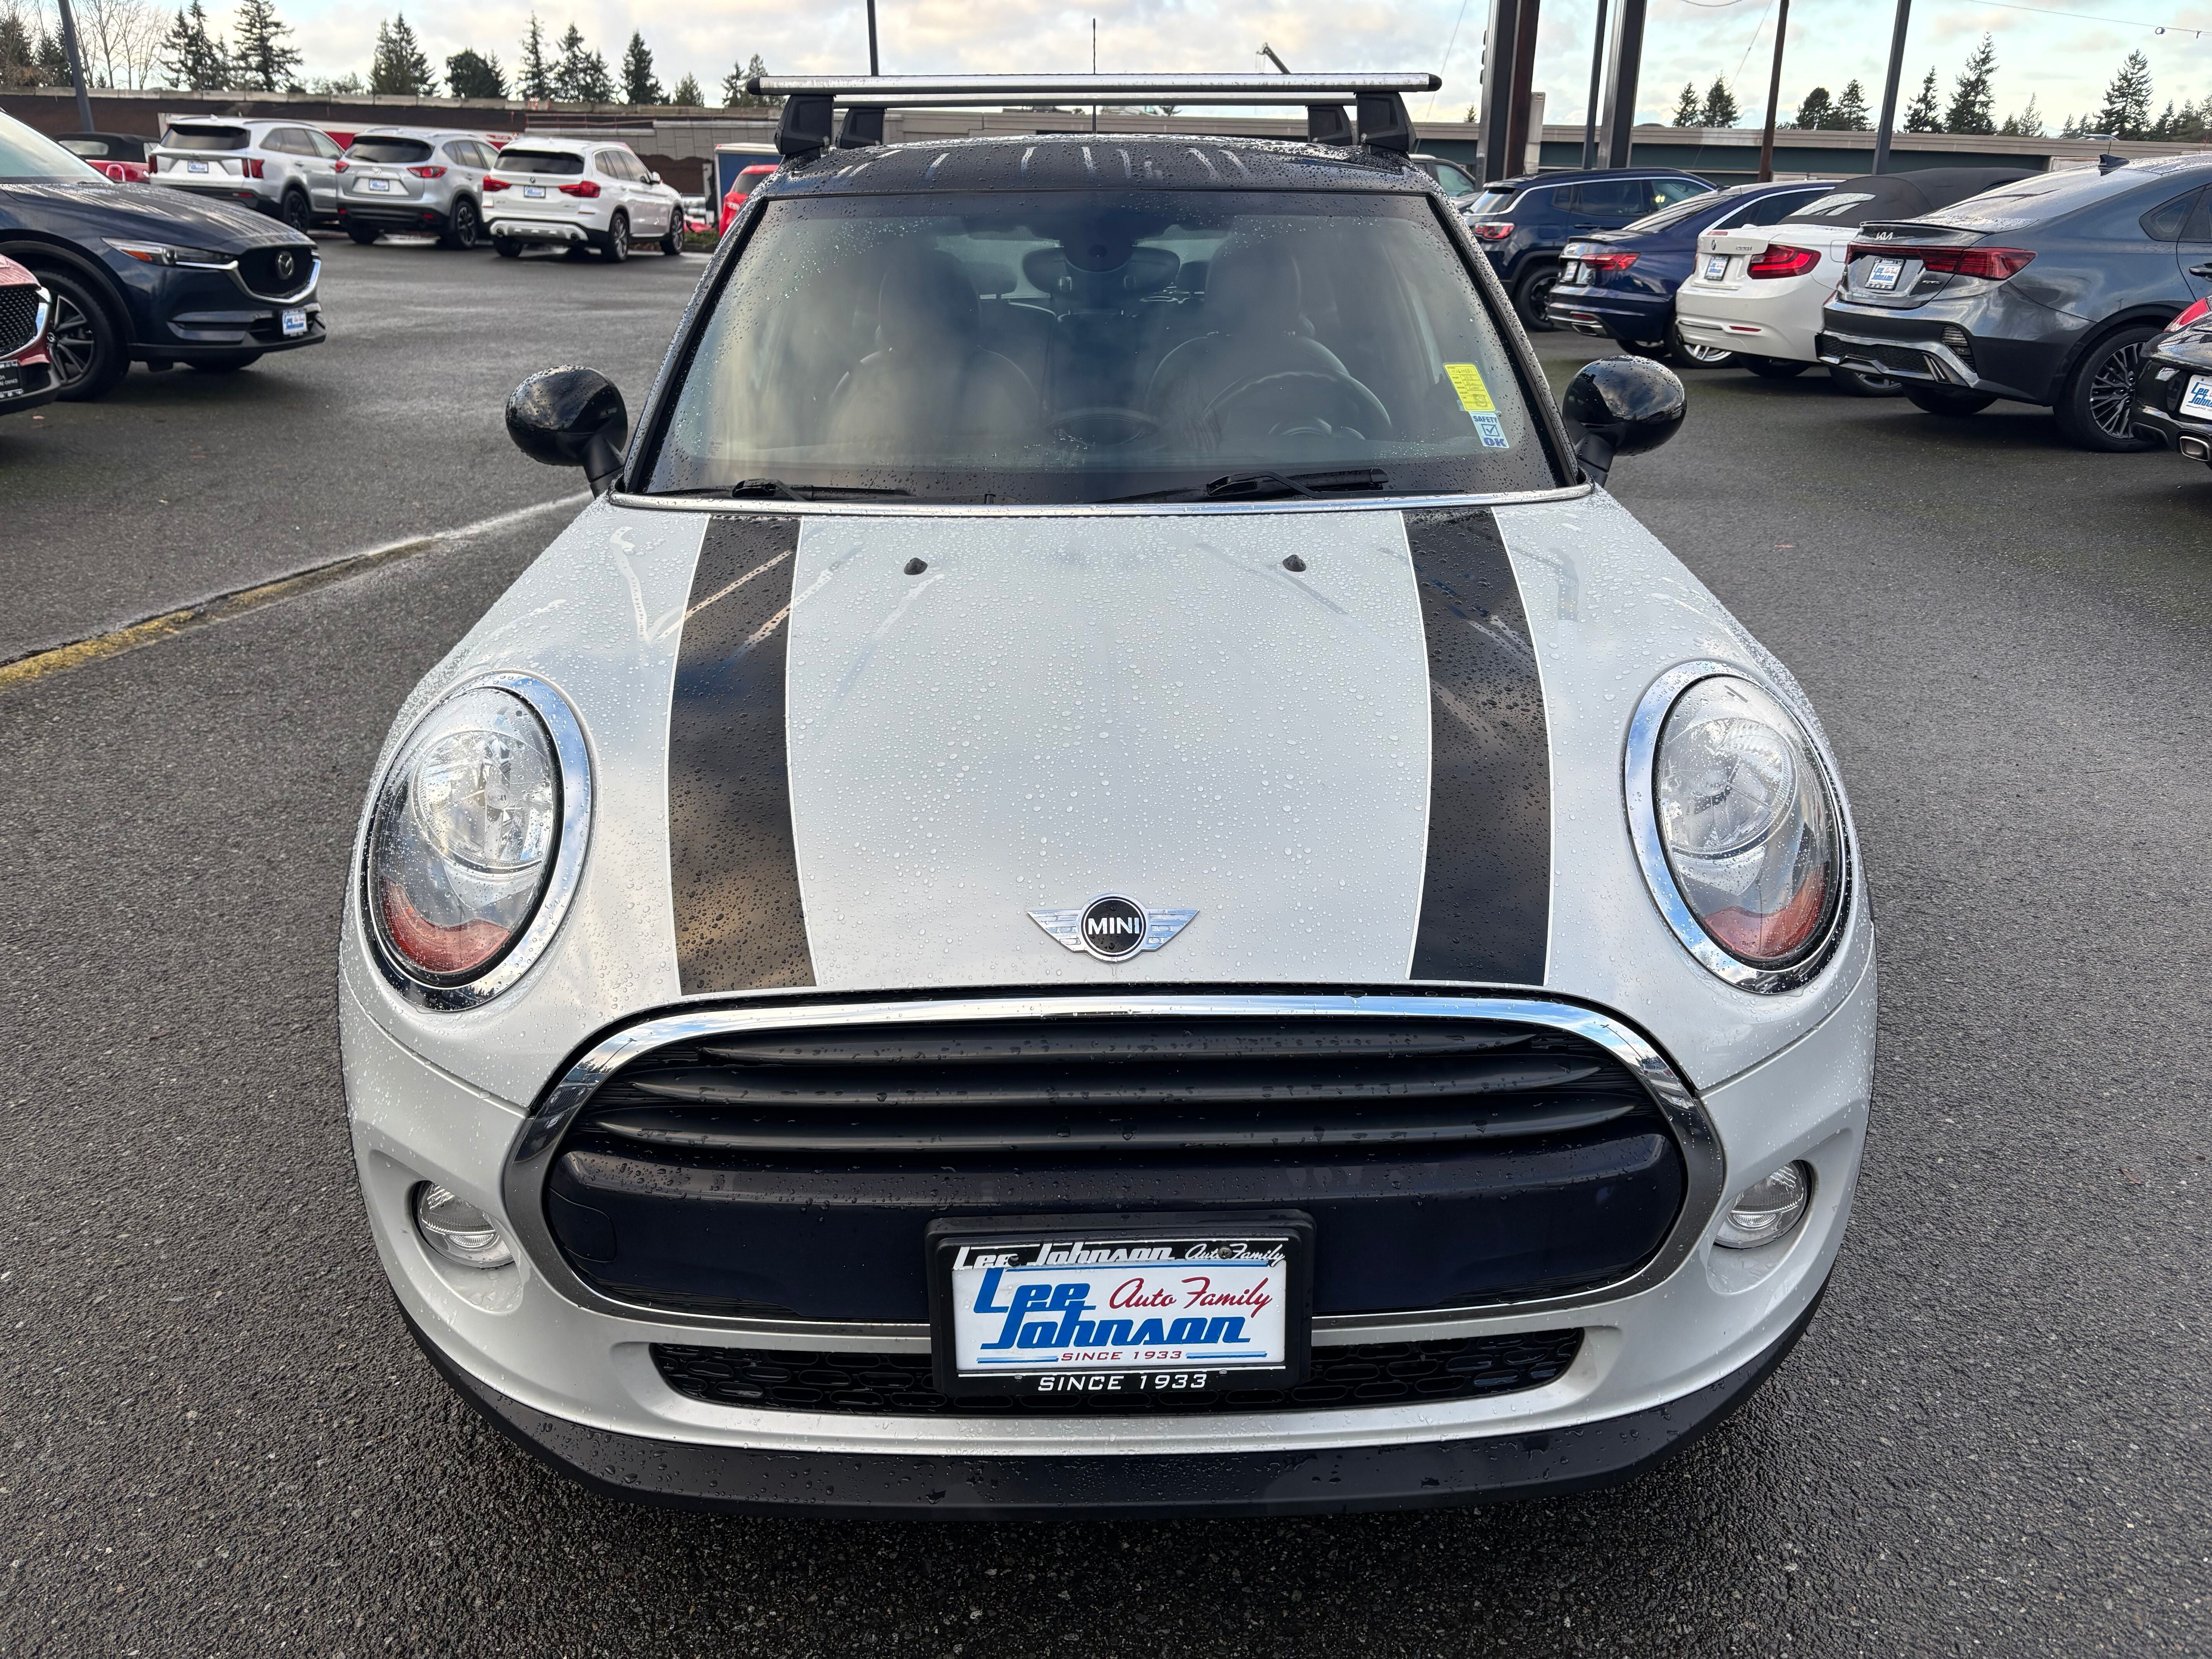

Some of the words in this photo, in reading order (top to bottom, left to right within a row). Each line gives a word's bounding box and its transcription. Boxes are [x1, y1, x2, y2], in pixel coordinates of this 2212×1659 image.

[2191, 382, 2209, 396] Lee
[1484, 438, 1507, 447] OK
[1088, 917, 1139, 934] MINI
[1027, 1242, 1176, 1266] Johnson
[1230, 1243, 1285, 1267] Family
[974, 1267, 1096, 1314] Lee
[1109, 1278, 1177, 1309] Auto
[1182, 1277, 1273, 1318] Family
[980, 1302, 1251, 1350] Johnson
[1061, 1352, 1123, 1361] SINCE
[1134, 1350, 1183, 1360] 1933
[1038, 1375, 1125, 1391] SINCE
[1140, 1373, 1207, 1389] 1933
